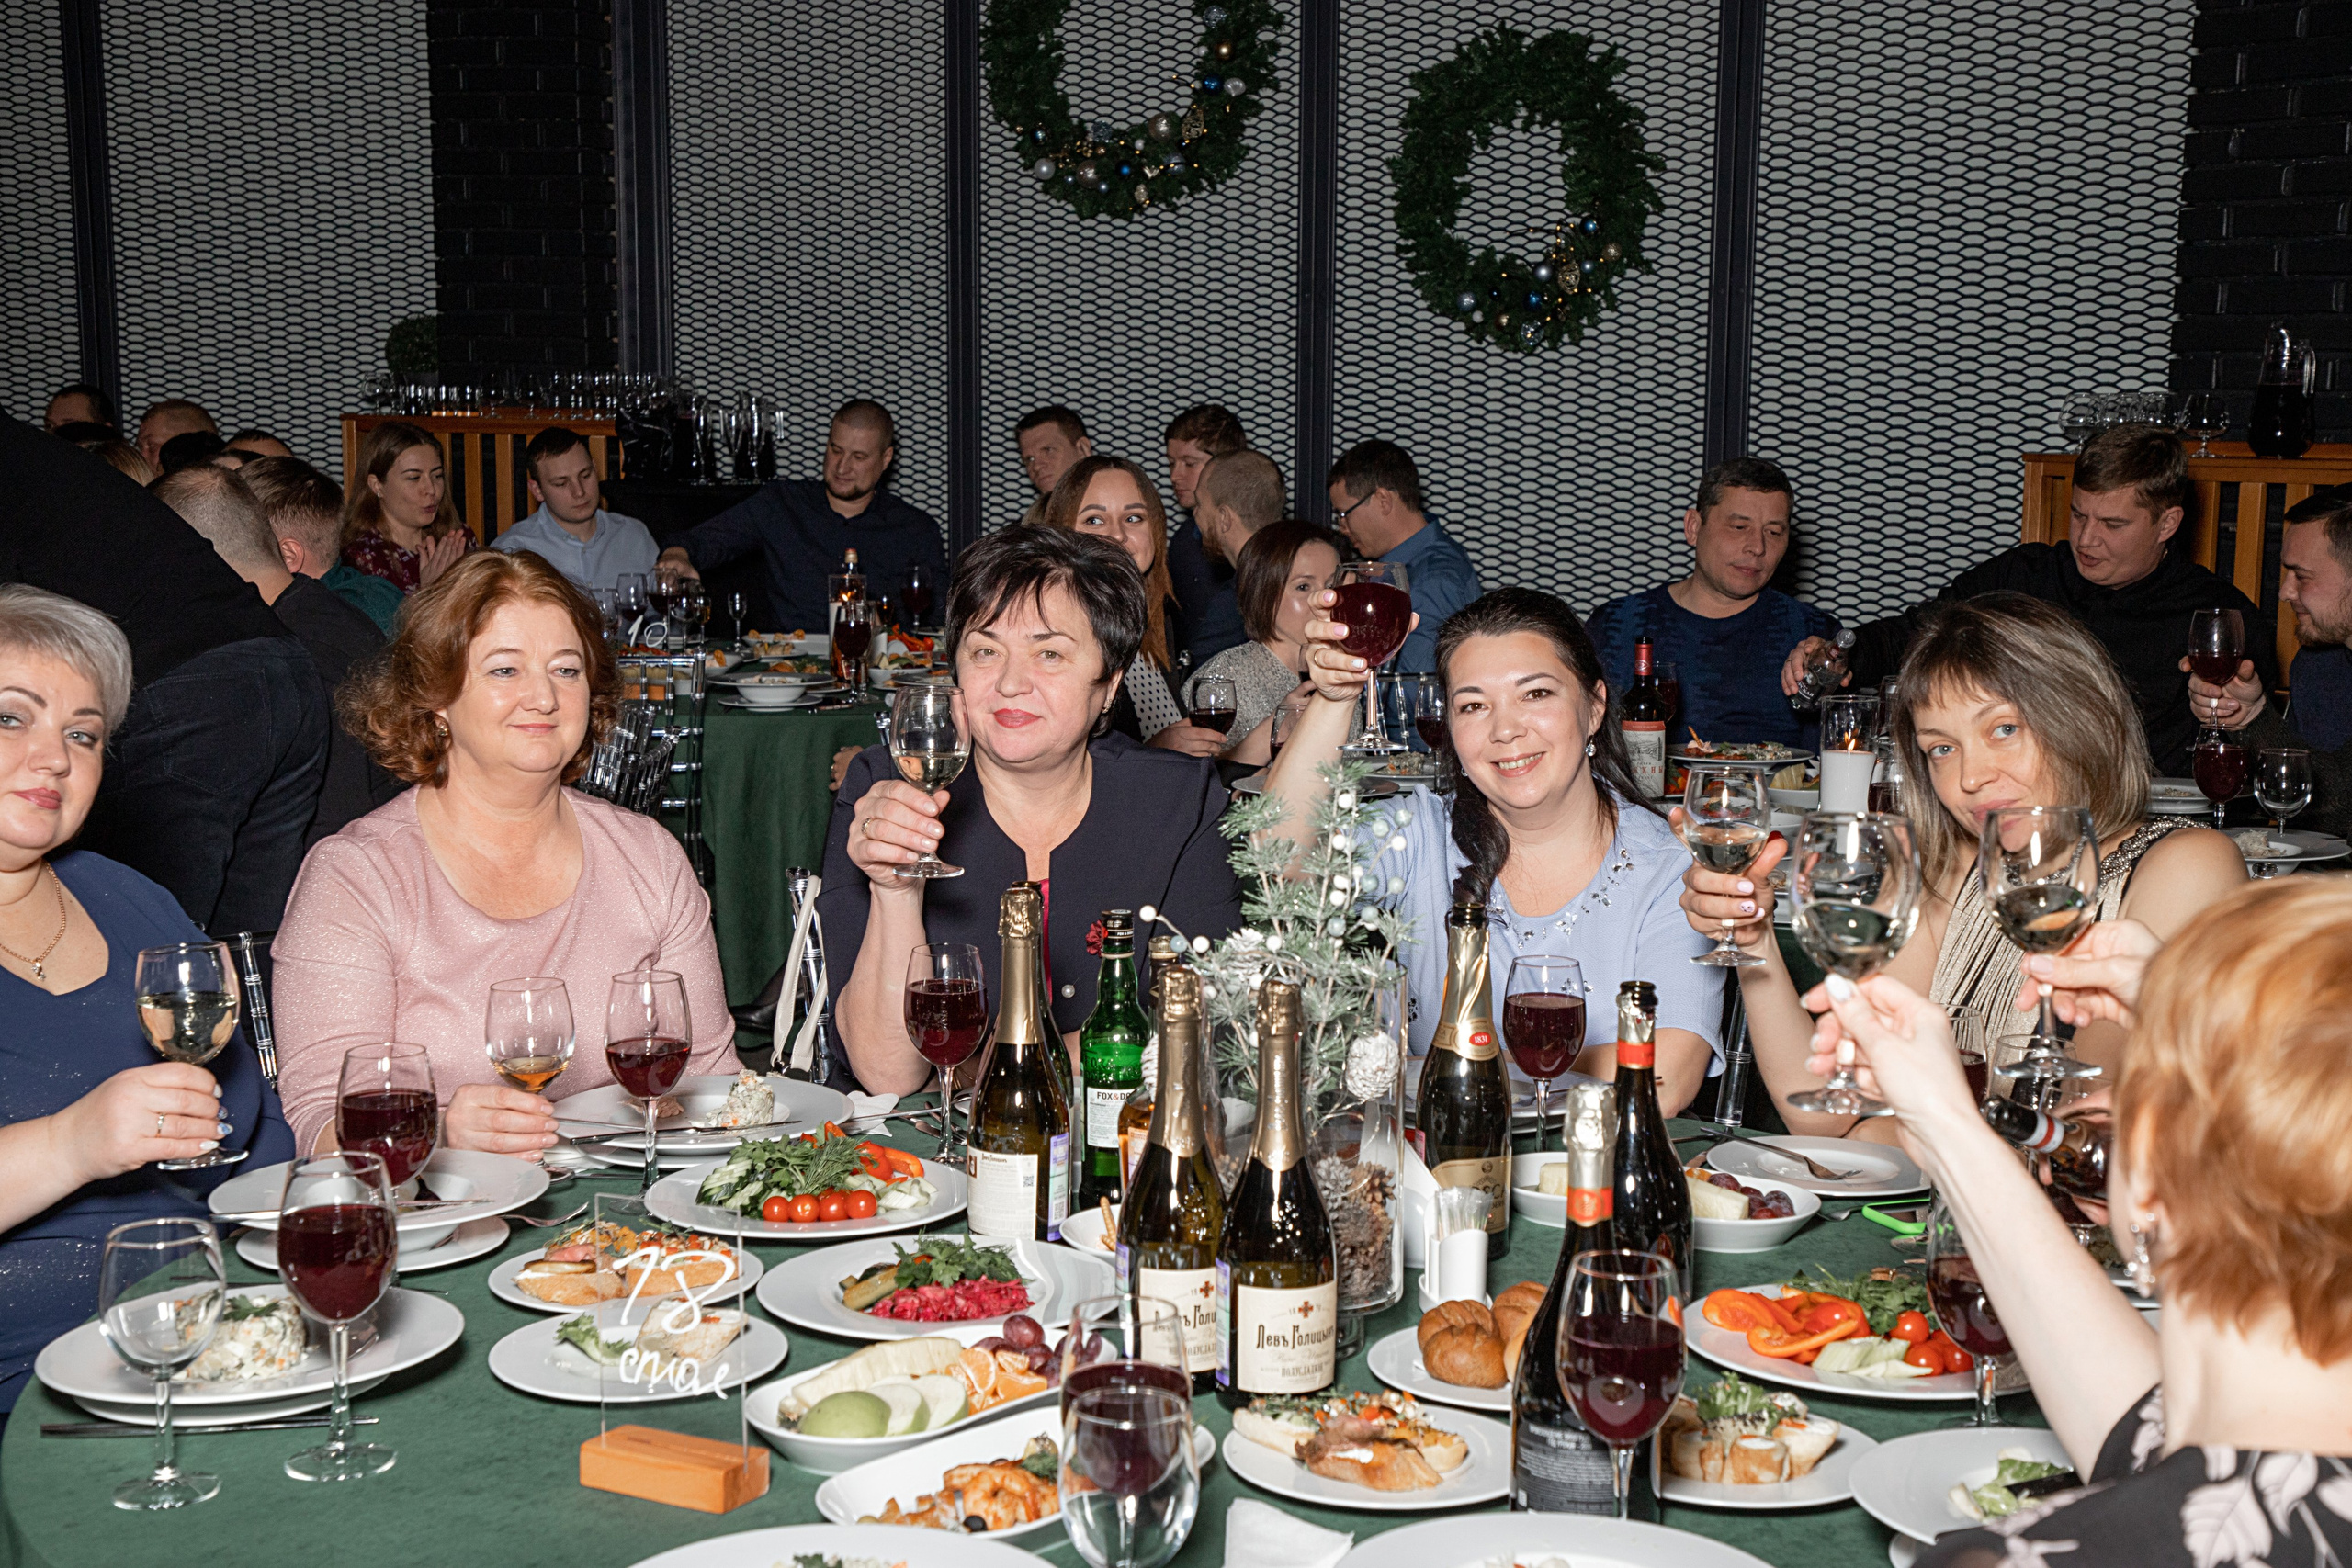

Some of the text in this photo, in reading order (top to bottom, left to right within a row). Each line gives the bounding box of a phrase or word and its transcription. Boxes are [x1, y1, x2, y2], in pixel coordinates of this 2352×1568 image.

[628, 615, 668, 648] 10
[1474, 1034, 1488, 1043] 1831
[613, 1246, 735, 1335] 18
